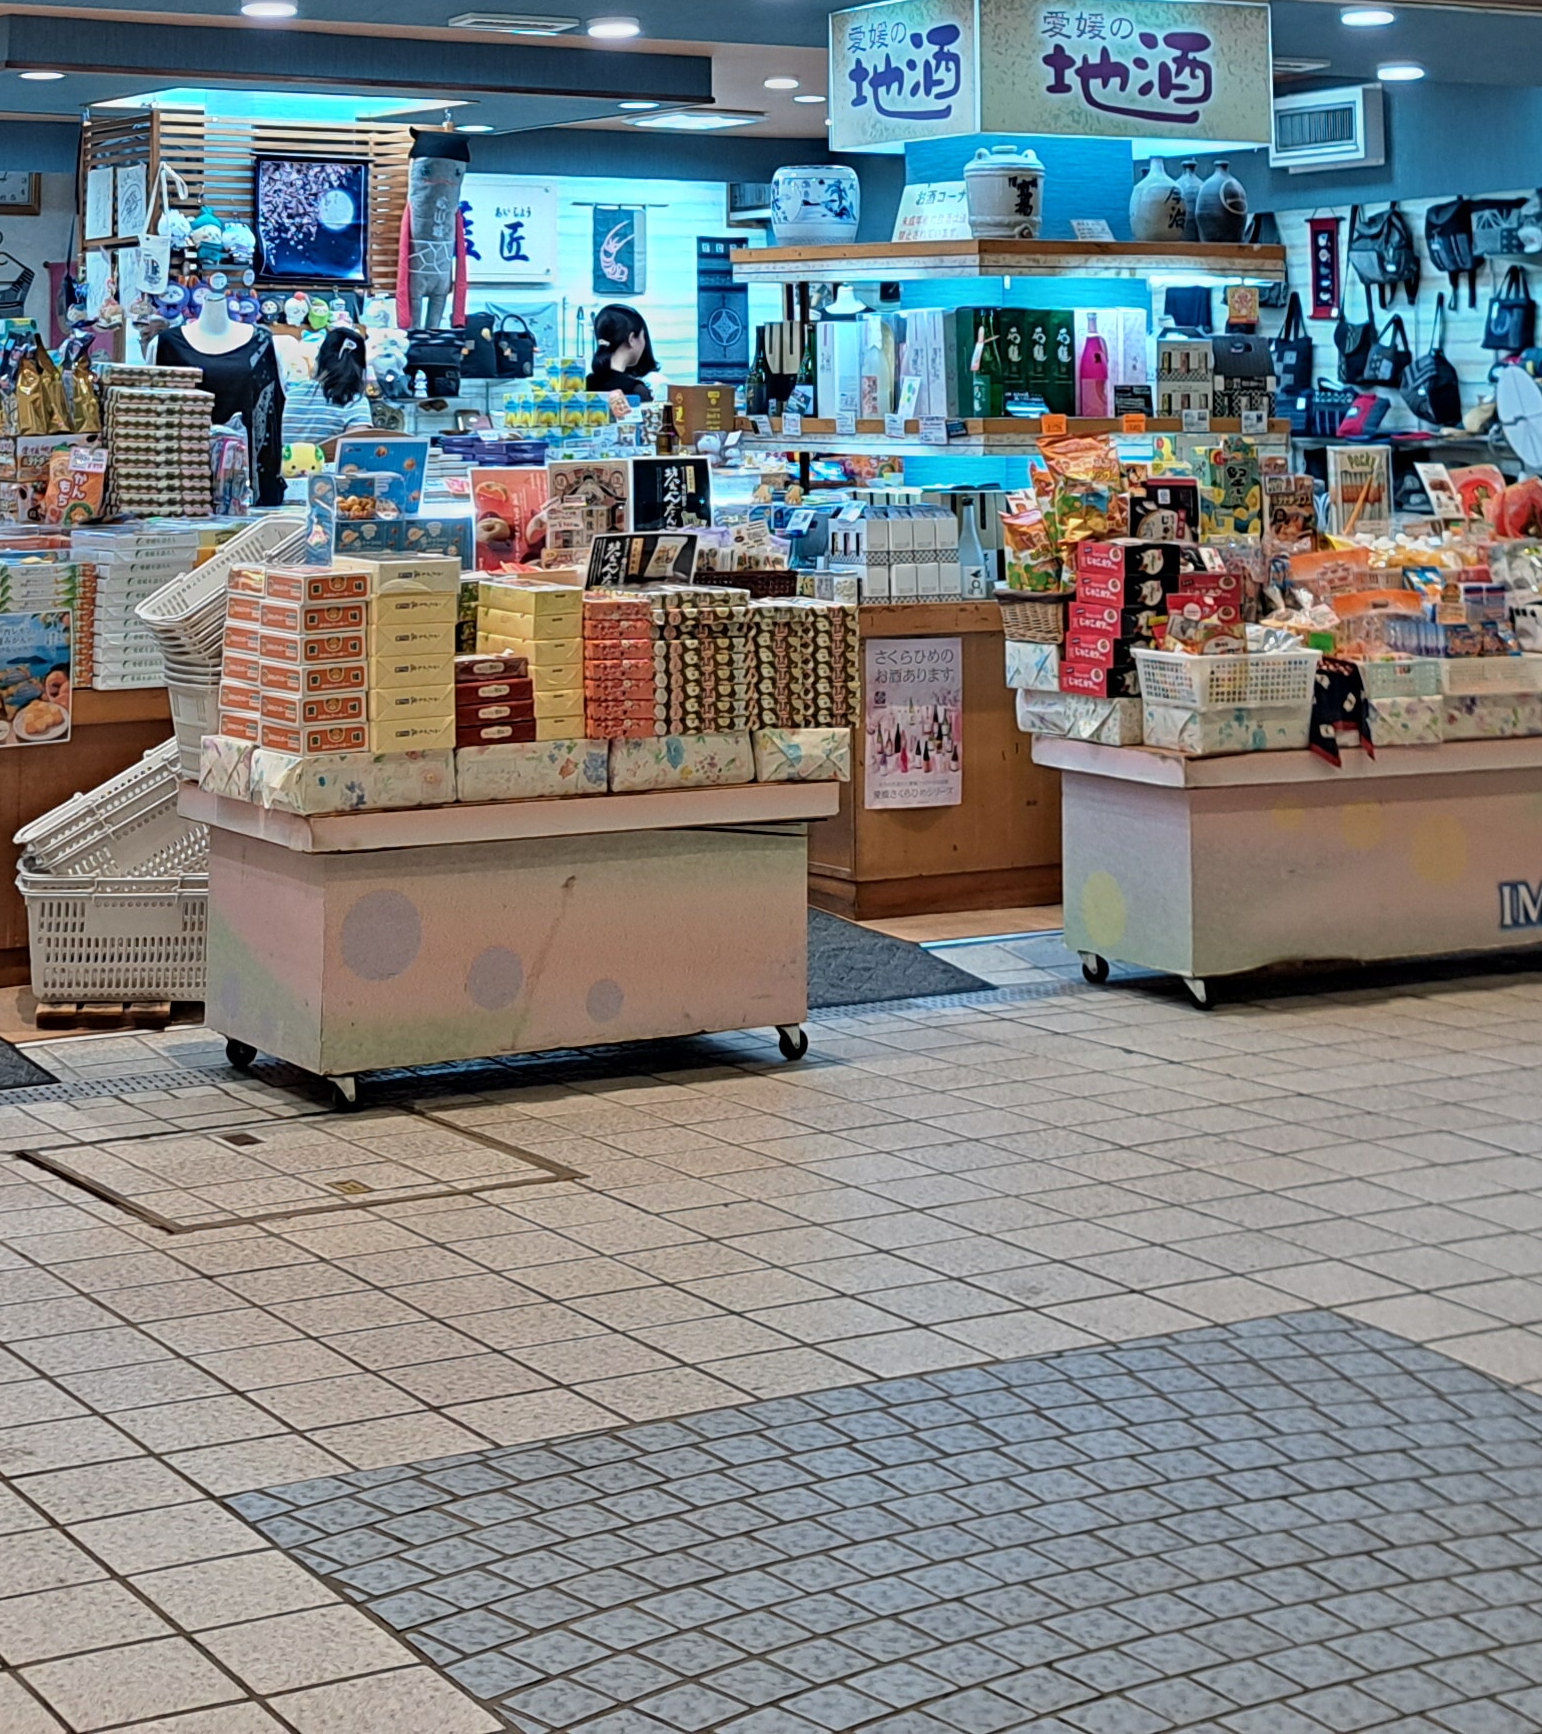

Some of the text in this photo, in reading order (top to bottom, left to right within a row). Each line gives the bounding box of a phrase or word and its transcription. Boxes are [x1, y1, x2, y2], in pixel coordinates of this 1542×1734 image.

[847, 21, 908, 51] 愛媛の
[1040, 10, 1134, 41] 愛媛の
[848, 24, 961, 120] 地酒
[1042, 32, 1212, 124] 地酒
[916, 190, 966, 206] お酒コーナ
[875, 649, 954, 665] さくらひめの
